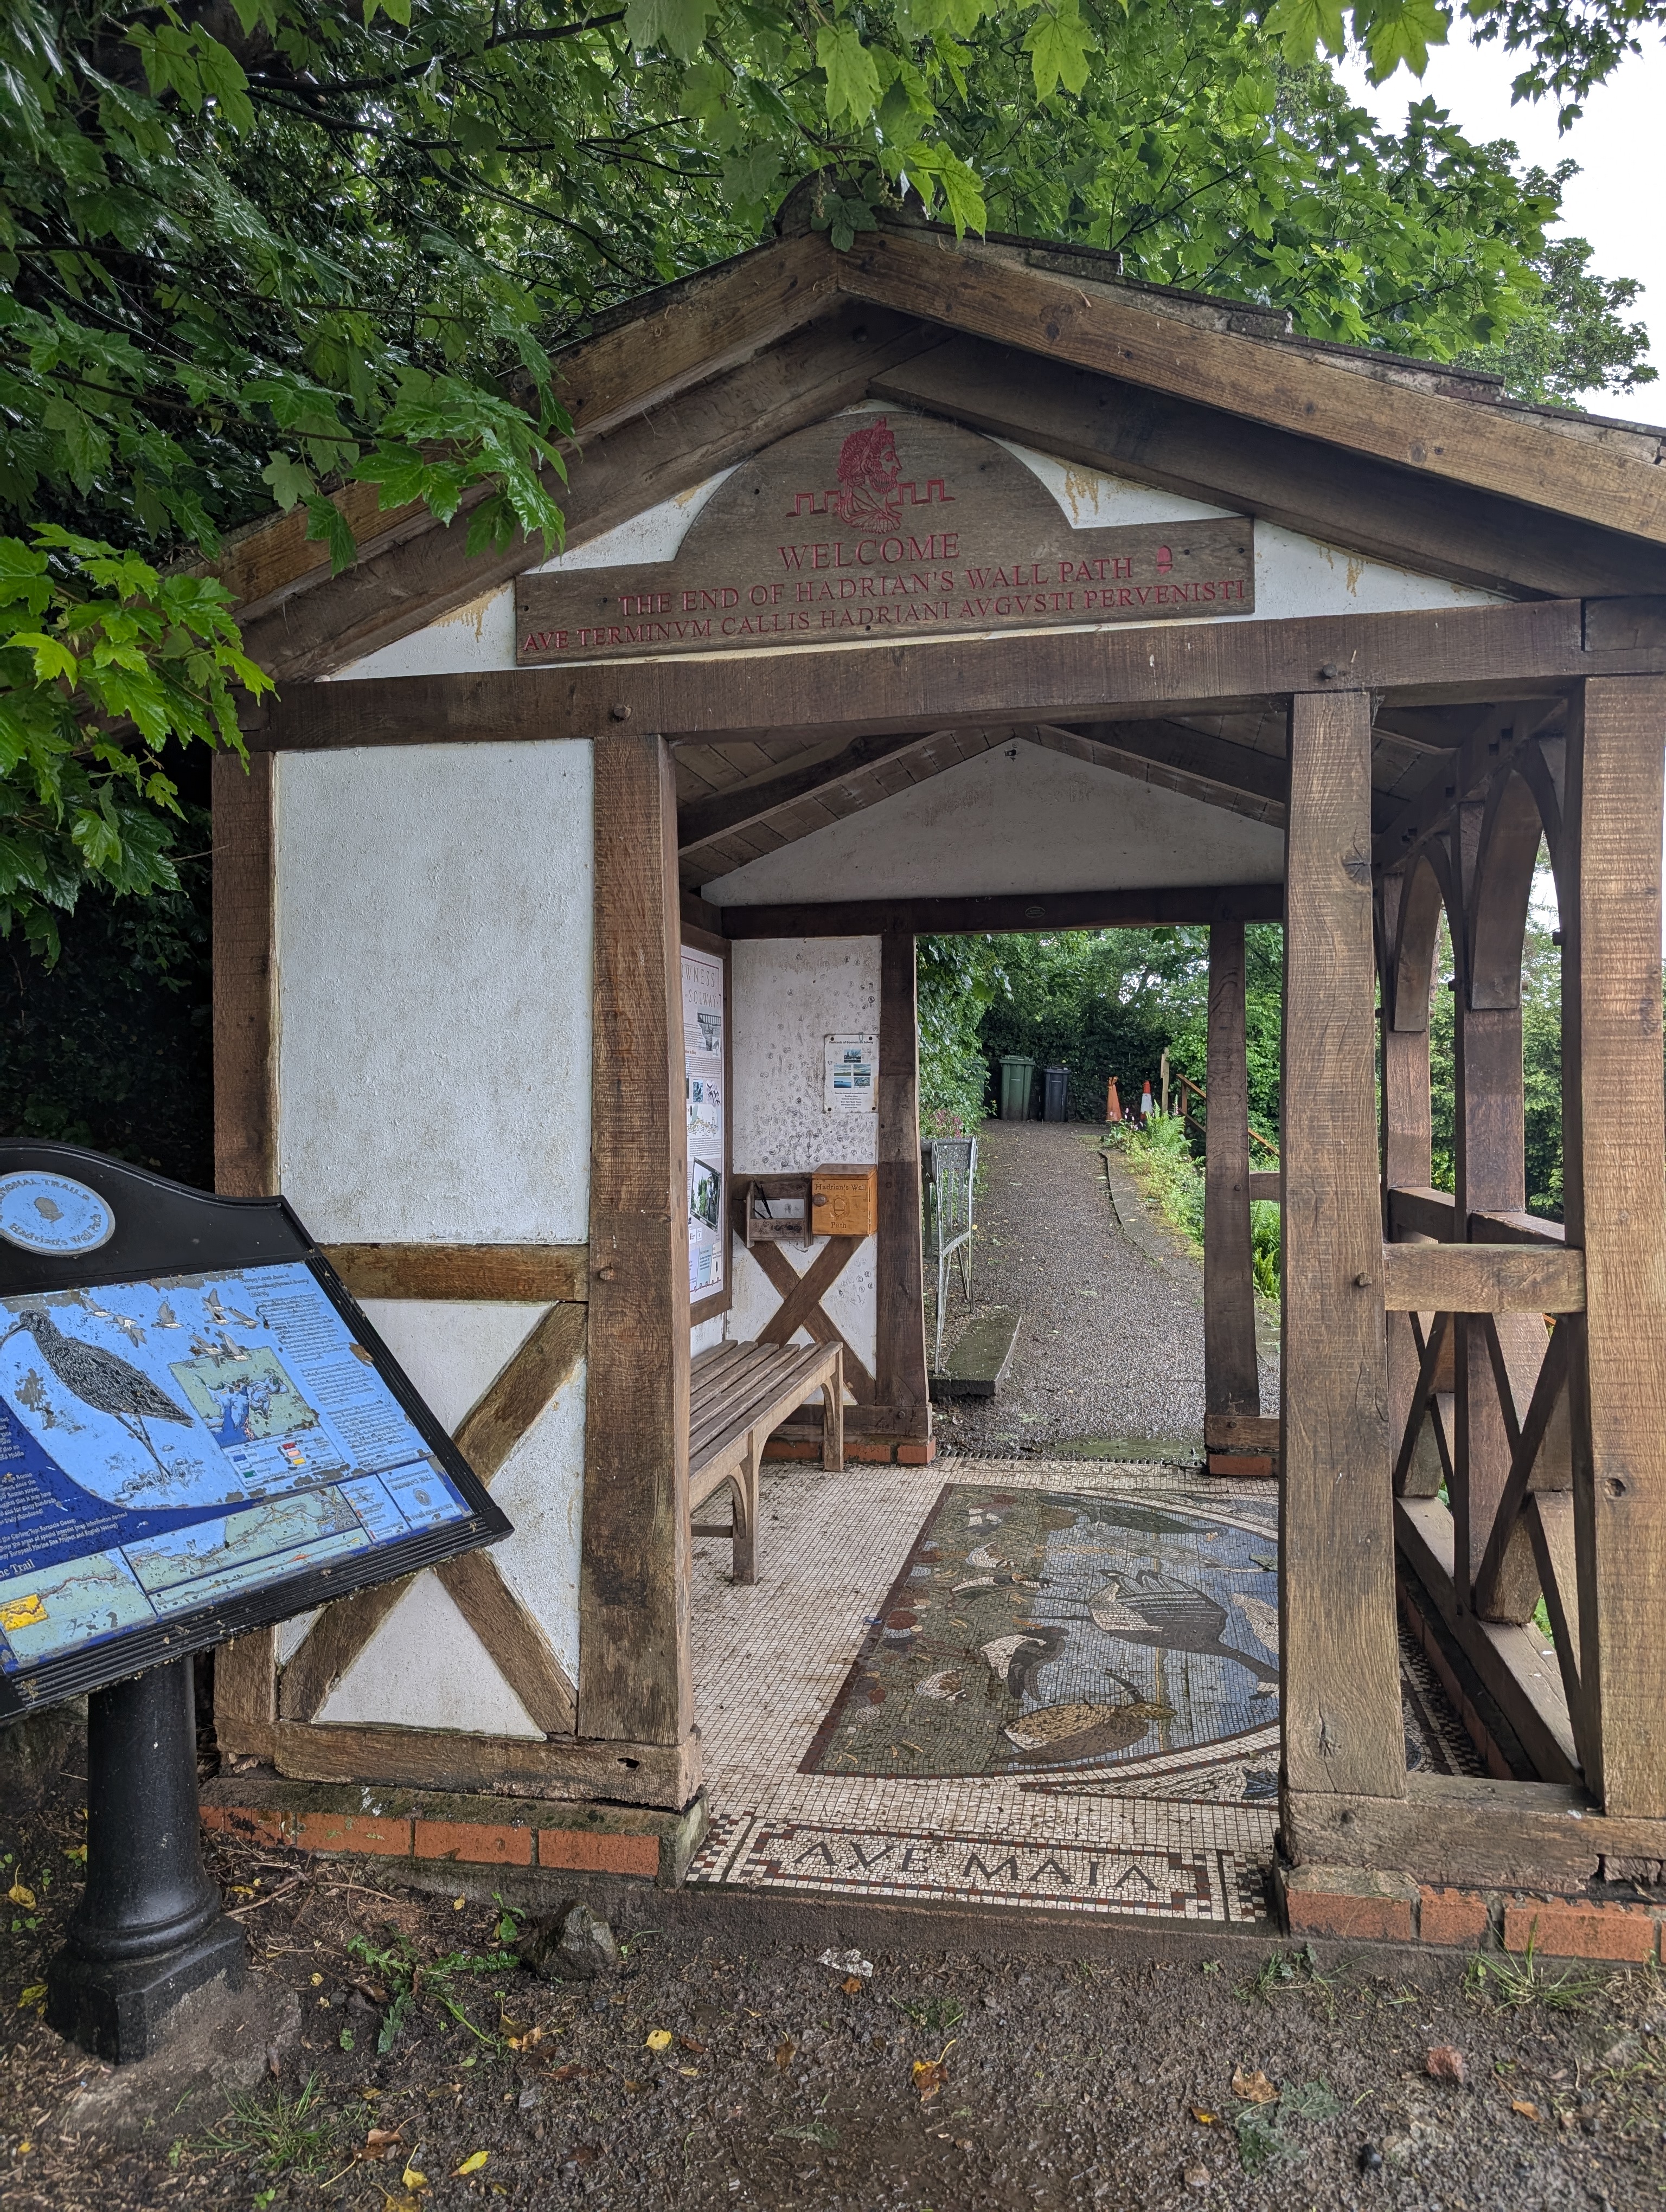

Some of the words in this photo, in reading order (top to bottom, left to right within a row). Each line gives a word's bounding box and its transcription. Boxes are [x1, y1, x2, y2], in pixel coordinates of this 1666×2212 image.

[778, 533, 960, 571] WELCOME
[618, 592, 672, 616] THE
[683, 587, 740, 613] END
[749, 583, 785, 607] OF
[796, 570, 954, 602] HADRIAN'S
[964, 564, 1049, 589] WALL
[1058, 557, 1133, 583] PATH
[523, 631, 569, 651] AVE
[576, 620, 712, 646] TERMINVM
[722, 612, 810, 636] CALLIS
[821, 601, 950, 628] HADRIANI
[959, 591, 1074, 618] AVGVSTI
[1084, 580, 1245, 609] PERVENISTI
[681, 963, 714, 987] WNESS
[689, 989, 716, 1007] SOLWAY
[41, 1179, 91, 1201] TRAILS
[67, 1229, 95, 1244] Wall
[32, 1542, 49, 1552] Marine
[10, 1559, 36, 1573] Trail
[794, 1841, 933, 1874] AVE
[963, 1851, 1162, 1892] MAIA
